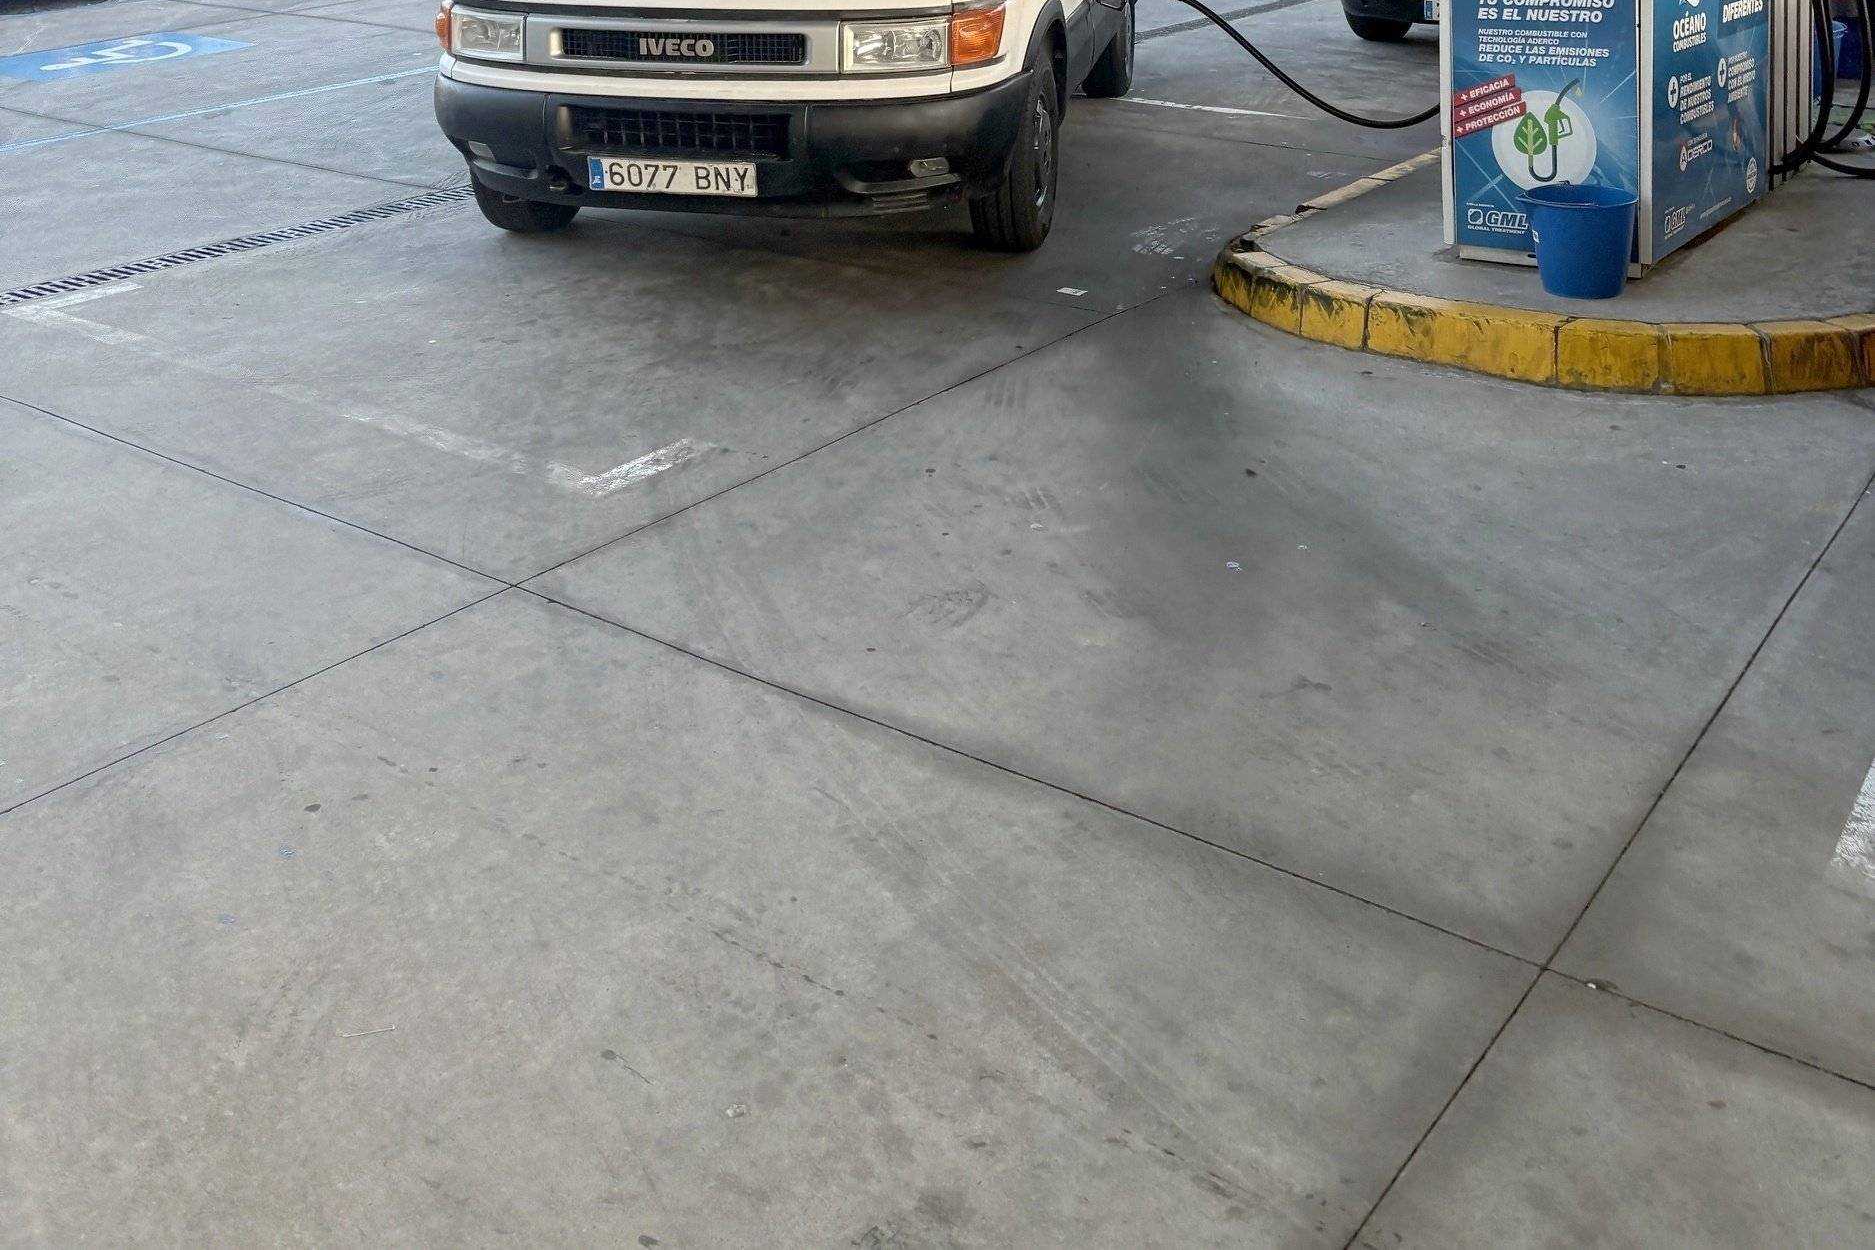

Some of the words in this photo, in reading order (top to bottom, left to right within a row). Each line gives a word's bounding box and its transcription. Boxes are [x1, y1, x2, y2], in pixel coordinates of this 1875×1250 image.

[1478, 7, 1498, 19] ES
[1502, 8, 1522, 20] EL
[1526, 9, 1602, 23] NUESTRO
[1673, 10, 1706, 40] OCÉANO
[1478, 28, 1513, 36] NUESTRO
[1515, 30, 1569, 38] COMBUSTIBLE
[1478, 35, 1525, 44] TECNOLOGÍA
[1527, 37, 1559, 45] ADERCO
[1673, 32, 1706, 53] COMBUSTIBLES
[639, 37, 715, 57] IVECO
[1478, 44, 1522, 53] REDUCE
[1525, 45, 1546, 54] LAS
[1549, 47, 1610, 58] EMISIONES
[1478, 53, 1494, 62] DE
[1519, 55, 1527, 63] Y
[1529, 55, 1597, 67] PARTÍCULAS
[1470, 78, 1510, 98] EFICACIA
[1468, 92, 1515, 114] ECONOMÍA
[608, 162, 678, 189] 6077
[694, 165, 749, 192] BNY
[1486, 210, 1529, 230] GML
